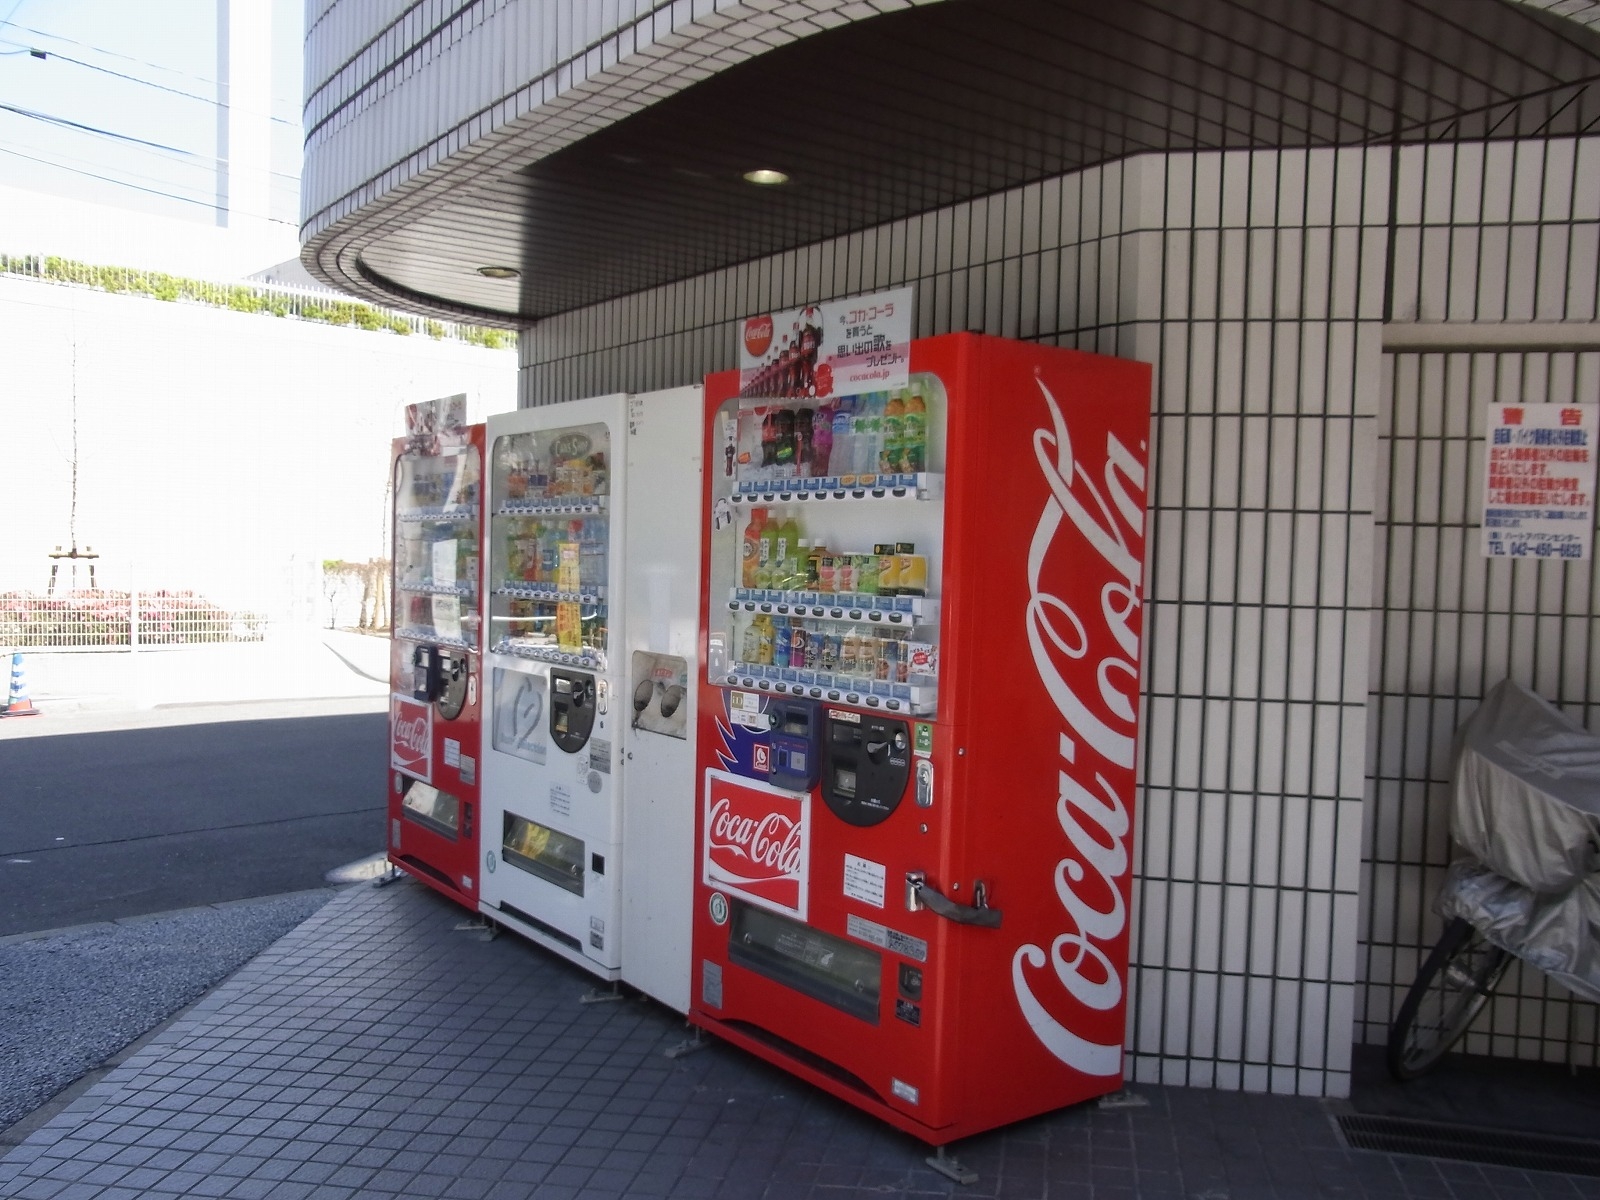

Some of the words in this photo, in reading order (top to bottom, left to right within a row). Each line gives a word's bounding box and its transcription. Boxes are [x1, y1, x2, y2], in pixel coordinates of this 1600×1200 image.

[846, 324, 873, 339] を買うと
[837, 334, 892, 358] 思い出の歌を
[1488, 541, 1506, 555] TEL
[1012, 376, 1147, 1076] Coca-Cola
[710, 798, 801, 873] Coca-Cola
